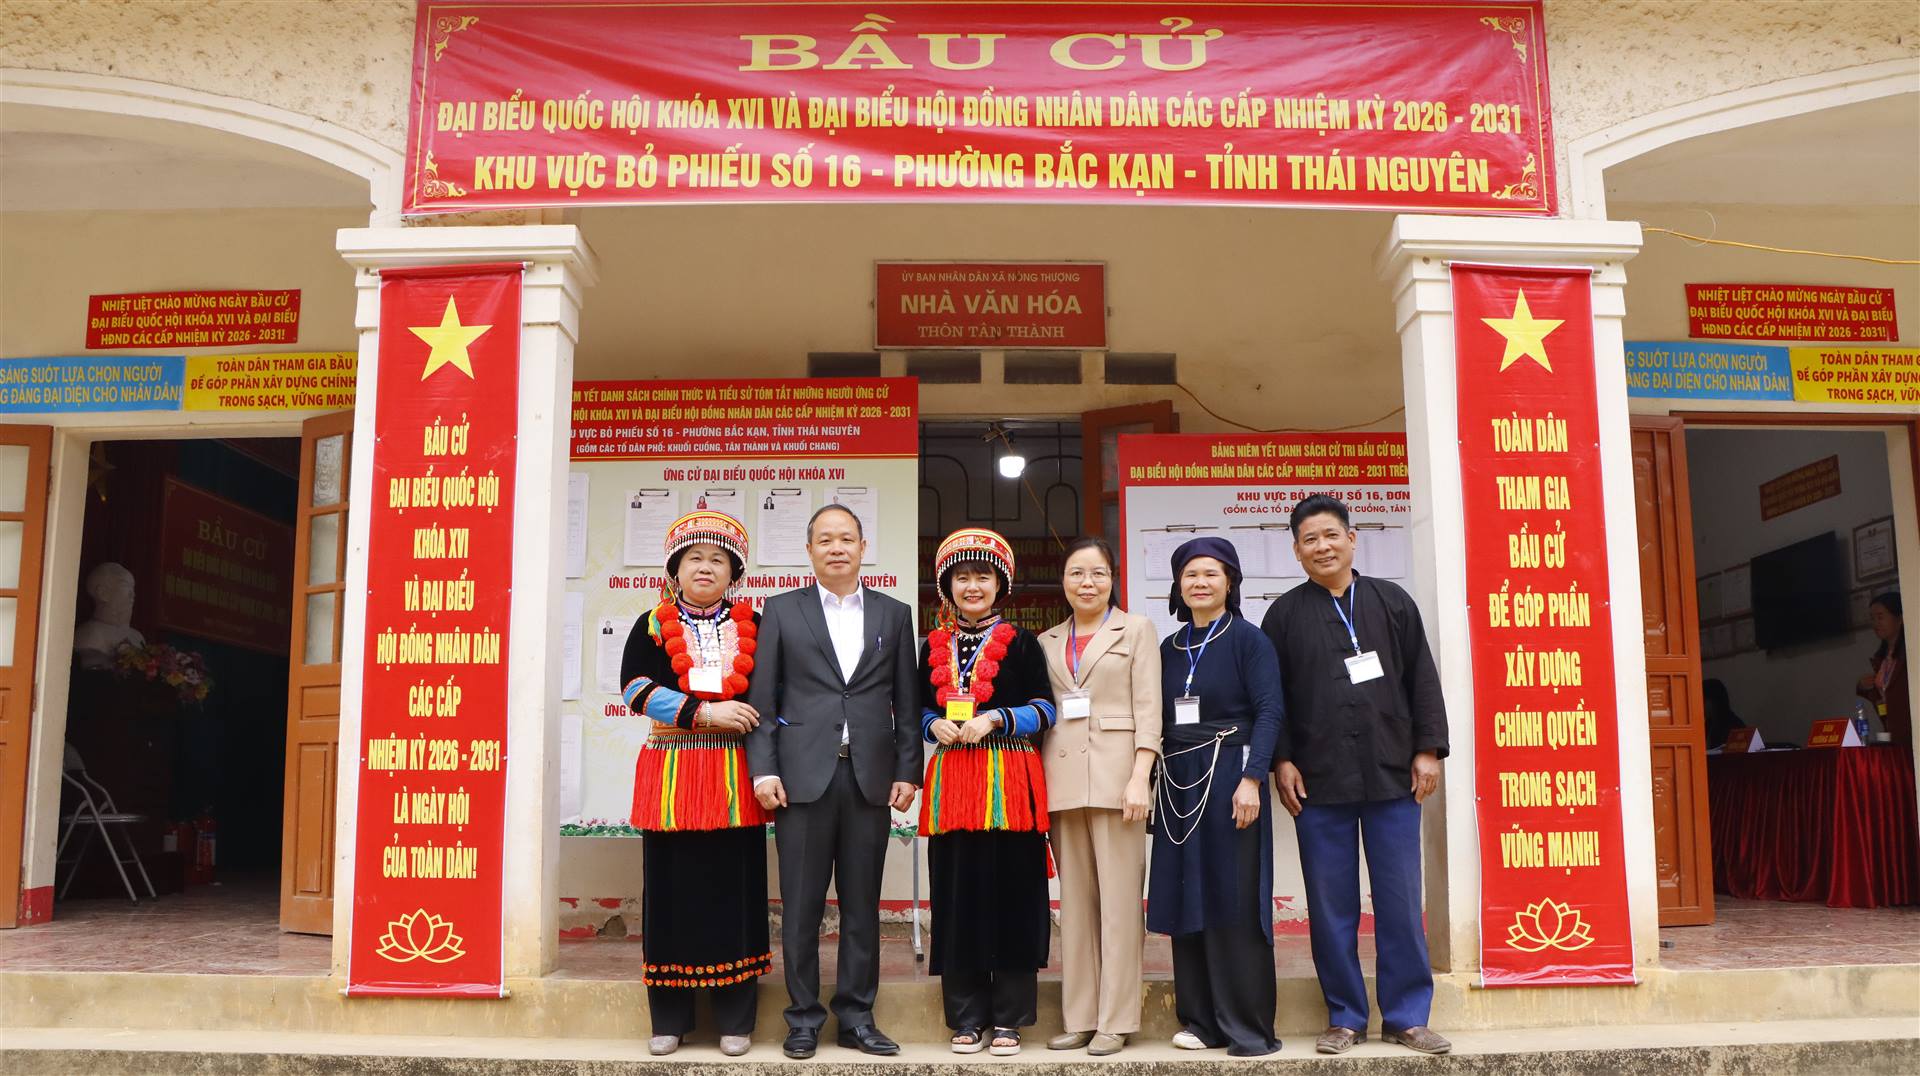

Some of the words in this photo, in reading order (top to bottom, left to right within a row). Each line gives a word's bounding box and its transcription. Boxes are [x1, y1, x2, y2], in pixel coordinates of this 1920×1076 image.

[739, 12, 1007, 72] BẦU
[1050, 16, 1225, 72] CỬ
[438, 100, 477, 138] ĐẠI
[483, 88, 536, 132] BIỂU
[543, 96, 603, 133] QUỐC
[610, 96, 650, 137] HỘI
[658, 90, 719, 128] KHÓA
[728, 96, 764, 128] XVI
[772, 96, 802, 129] VÀ
[807, 98, 847, 136] ĐẠI
[855, 84, 909, 129] BIỂU
[917, 89, 955, 135] HỘI
[963, 87, 1029, 128] ĐỒNG
[1035, 93, 1101, 128] NHÂN
[1109, 91, 1159, 129] DÂN
[1166, 92, 1214, 129] CÁC
[1220, 90, 1267, 129] CẤP
[1275, 95, 1351, 137] NHIỆM
[1358, 94, 1384, 131] KỲ
[1394, 101, 1447, 132] 2026
[1455, 115, 1463, 123] -
[1471, 102, 1521, 134] 2031
[474, 156, 535, 191] KHU
[547, 152, 605, 197] VỰC
[616, 143, 656, 190] BỎ
[668, 144, 760, 189] PHIẾU
[771, 144, 813, 188] SỐ
[828, 155, 861, 189] 16
[896, 147, 1024, 187] PHƯỜNG
[1034, 141, 1098, 188] BẮC
[1109, 153, 1174, 195] KẠN
[1206, 144, 1278, 190] TỈNH
[1288, 149, 1356, 191] THÁI
[1367, 150, 1489, 192] NGUYÊN
[917, 273, 936, 282] BAN
[939, 271, 966, 282] NHÂN
[969, 271, 989, 282] DÂN
[992, 271, 1005, 282] XÃ
[1698, 288, 1729, 306] NHIỆT
[1732, 288, 1755, 306] LIỆT
[1755, 290, 1783, 303] CHÀO
[1787, 289, 1817, 303] MỪNG
[1820, 289, 1845, 304] NGÀY
[1848, 288, 1867, 304] BẦU
[1869, 290, 1882, 305] CỬ
[91, 317, 109, 329] ĐẠI
[111, 311, 134, 328] BIỂU
[136, 314, 161, 328] QUỐC
[165, 312, 182, 327] HỘI
[185, 313, 213, 326] KHÓA
[217, 313, 234, 325] XVI
[237, 312, 252, 325] VÀ
[253, 312, 271, 324] ĐẠI
[274, 307, 296, 323] BIỂU
[102, 298, 131, 314] NHIỆT
[133, 297, 153, 312] LIỆT
[154, 297, 181, 310] CHÀO
[184, 296, 216, 308] MỪNG
[219, 295, 248, 308] NGÀY
[251, 294, 272, 308] BẦU
[274, 293, 288, 307] CỬ
[902, 289, 955, 314] NHÀ
[964, 289, 1018, 314] VĂN
[1028, 289, 1082, 314] HÓA
[101, 333, 130, 345] HĐND
[132, 332, 152, 344] CÁC
[154, 329, 173, 344] CẤP
[176, 332, 208, 343] NHIỆM
[212, 330, 225, 343] KỲ
[229, 330, 250, 342] 2026
[259, 329, 285, 341] 2031!
[918, 322, 963, 337] THÔN
[968, 322, 1001, 338] TÂN
[1007, 323, 1064, 338] THÀNH
[217, 358, 244, 372] TOÀN
[248, 357, 269, 371] DÂN
[273, 359, 304, 370] THAM
[308, 359, 326, 370] GIA
[330, 354, 352, 370] BẦU
[424, 416, 448, 457] BẦU
[450, 413, 469, 457] CỬ
[1492, 412, 1533, 453] TOÀN
[1536, 412, 1568, 453] DÂN
[389, 478, 410, 512] ĐẠI
[411, 466, 440, 508] BIỂU
[442, 466, 475, 510] QUỐC
[477, 469, 499, 512] HỘI
[664, 468, 684, 481] ỨNG
[688, 466, 701, 481] CỬ
[704, 469, 720, 483] ĐẠI
[723, 465, 745, 480] BIỂU
[749, 465, 775, 482] QUỐC
[779, 467, 795, 482] HỘI
[799, 466, 825, 480] KHÓA
[829, 468, 844, 480] XVI
[1131, 467, 1146, 479] ĐẠI
[1146, 465, 1168, 479] BIỂU
[1168, 465, 1184, 479] HỘI
[1185, 465, 1208, 480] ĐỒNG
[1211, 466, 1236, 478] NHÂN
[1236, 465, 1256, 478] DÂN
[1256, 465, 1274, 478] CÁC
[1276, 464, 1294, 478] CẤP
[1296, 464, 1323, 479] NHIỆM
[1325, 464, 1336, 478] KỲ
[1339, 465, 1359, 477] 2026
[1367, 465, 1386, 477] 2031
[1497, 476, 1542, 510] THAM
[1544, 475, 1571, 510] GIA
[414, 524, 446, 560] KHÓA
[449, 528, 468, 559] XVI
[1509, 524, 1540, 569] BẦU
[1544, 520, 1566, 570] CỬ
[404, 576, 423, 611] VÀ
[422, 579, 443, 618] ĐẠI
[446, 568, 474, 611] BIỂU
[1489, 580, 1510, 628] ĐỂ
[1514, 586, 1549, 628] GÓP
[1548, 581, 1590, 627] PHẦN
[377, 627, 397, 671] HỘI
[400, 623, 433, 664] ĐỒNG
[435, 627, 470, 664] NHÂN
[472, 626, 500, 665] DÂN
[1505, 644, 1535, 687] XÂY
[1539, 648, 1582, 694] DỰNG
[409, 680, 433, 717] CÁC
[436, 675, 461, 719] CẤP
[1495, 704, 1544, 748] CHÍNH
[1547, 699, 1597, 750] QUYỀN
[368, 733, 407, 777] NHIỆM
[410, 734, 429, 770] KỲ
[428, 739, 458, 770] 2026
[470, 739, 499, 771] 2031
[393, 786, 409, 825] LÀ
[412, 787, 445, 824] NGÀY
[448, 786, 470, 832] HỘI
[1500, 771, 1552, 807] TRONG
[1555, 769, 1596, 814] SẠCH
[384, 833, 407, 878] CỦA
[411, 840, 443, 879] TOÀN
[446, 841, 477, 879] DÂN!
[1501, 824, 1544, 869] VỮNG
[1548, 832, 1599, 875] MẠNH!
